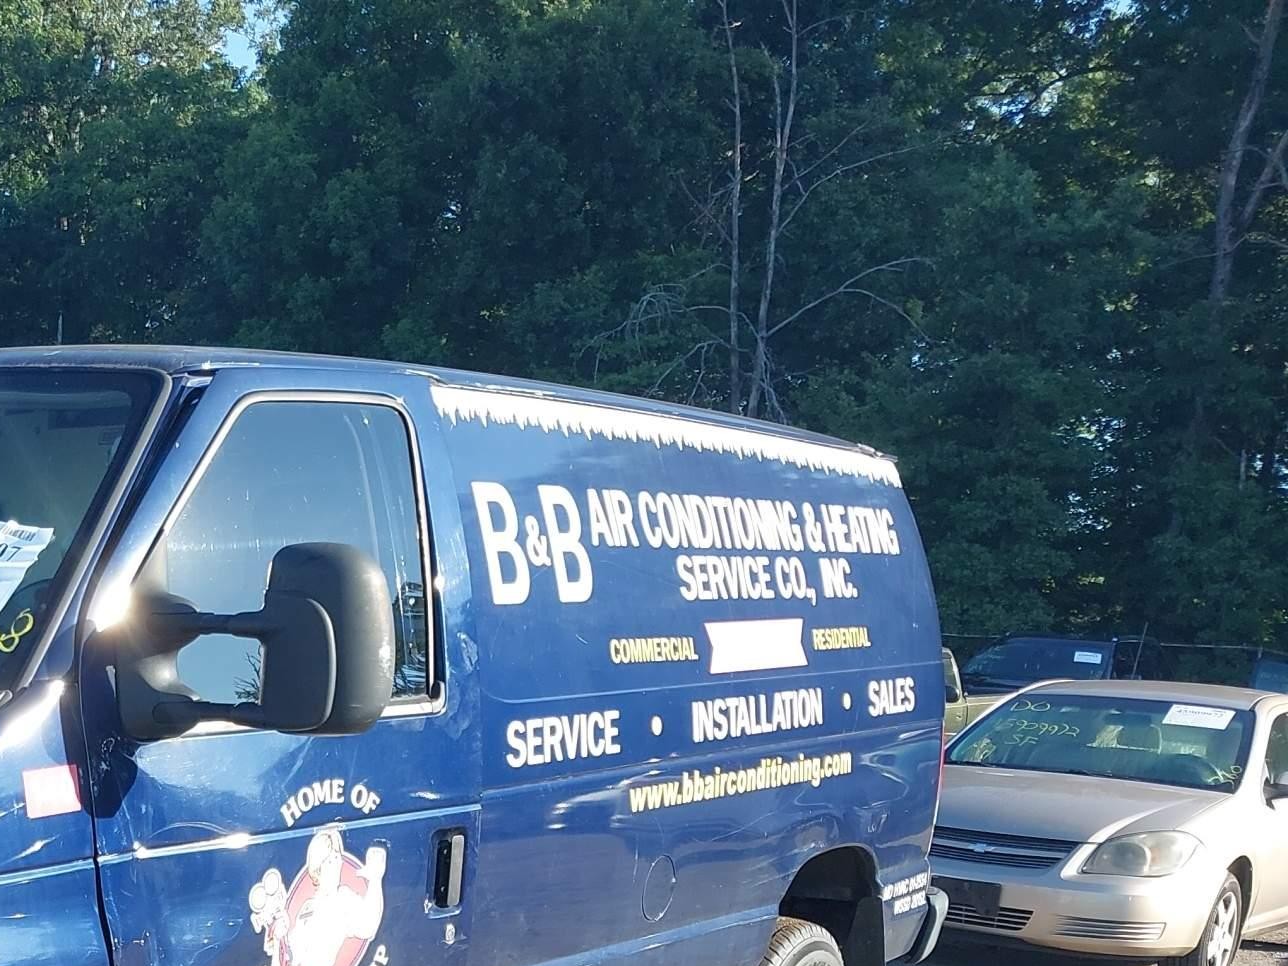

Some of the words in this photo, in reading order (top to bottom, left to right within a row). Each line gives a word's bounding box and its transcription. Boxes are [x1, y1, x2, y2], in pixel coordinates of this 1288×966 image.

[470, 481, 594, 605] B&B
[587, 488, 637, 548] AIR
[638, 490, 802, 552] CONDITIONING
[805, 501, 825, 553] &
[822, 503, 900, 555] HEATING
[676, 555, 772, 601] SERVICE
[821, 560, 858, 599] INC.
[610, 637, 699, 664] COMMERCIAL
[811, 626, 872, 650] RESIDENTIAL
[506, 710, 621, 768] SERVICE
[691, 688, 824, 743] INSTALLATION
[867, 677, 915, 718] SALES
[279, 778, 346, 828] HOME
[350, 782, 382, 815] OF
[629, 752, 853, 813] www.bbairconditioning.com
